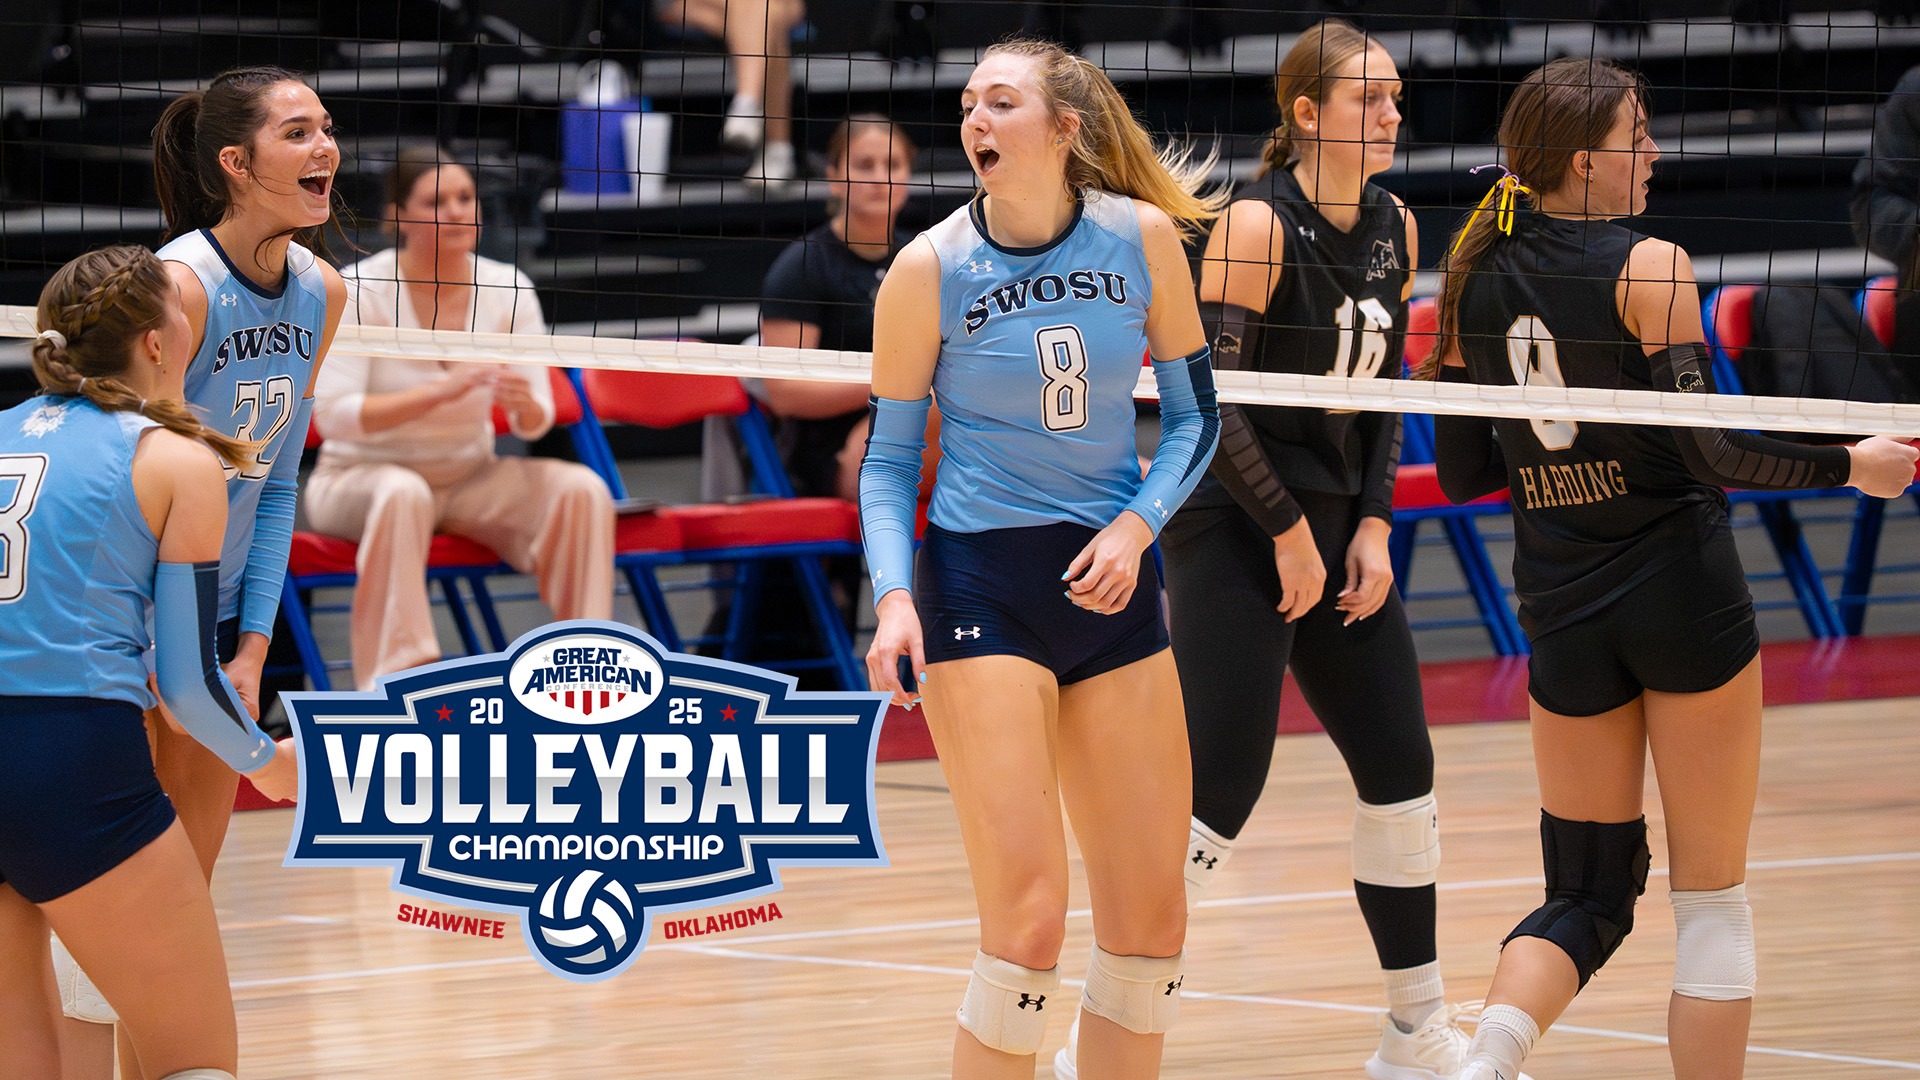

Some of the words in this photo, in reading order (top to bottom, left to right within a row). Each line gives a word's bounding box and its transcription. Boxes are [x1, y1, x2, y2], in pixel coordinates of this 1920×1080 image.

[963, 270, 1128, 336] SWOSU
[1034, 324, 1089, 433] 8
[1519, 460, 1628, 509] HARDING
